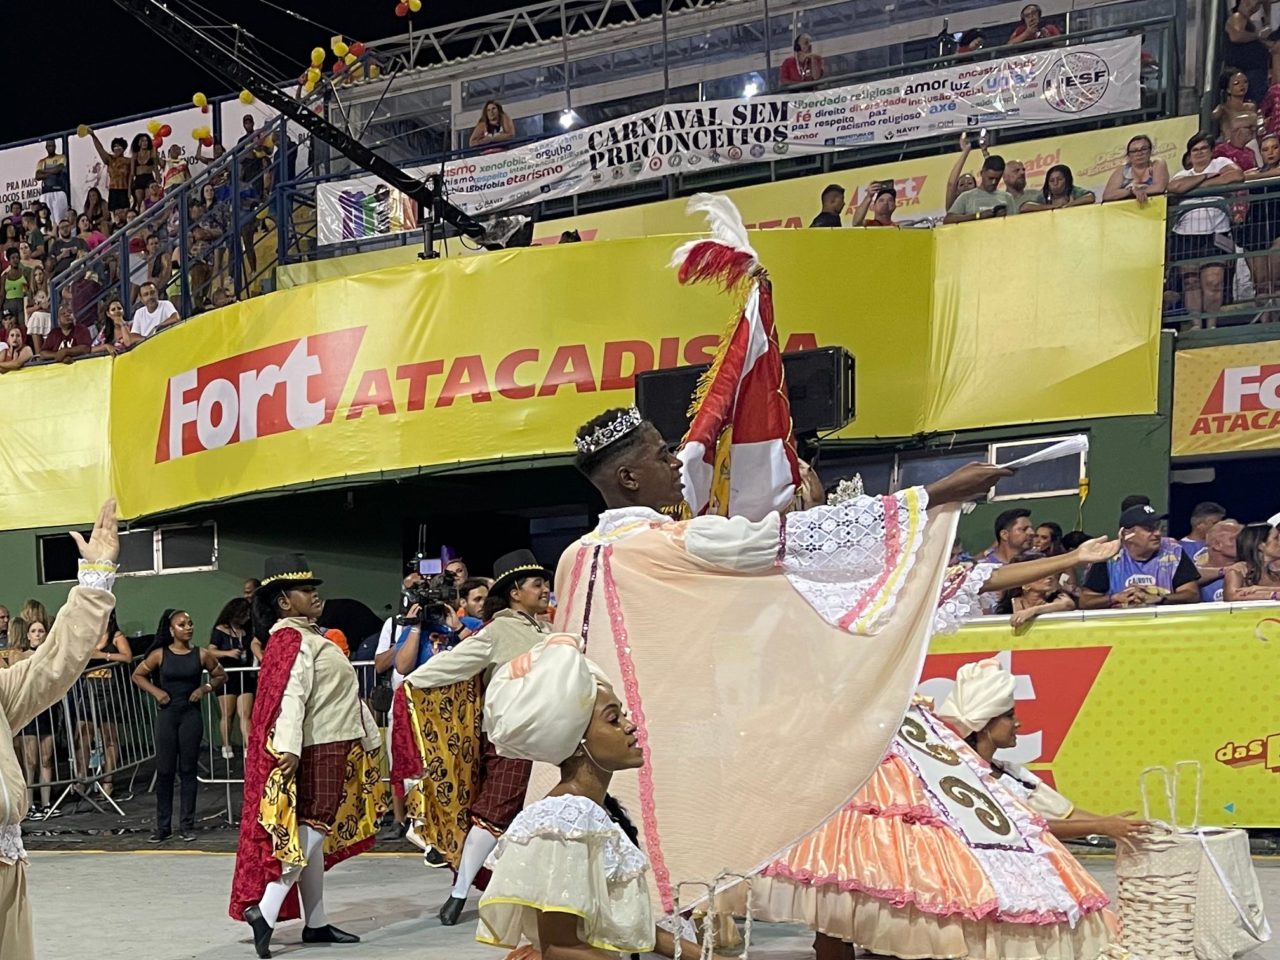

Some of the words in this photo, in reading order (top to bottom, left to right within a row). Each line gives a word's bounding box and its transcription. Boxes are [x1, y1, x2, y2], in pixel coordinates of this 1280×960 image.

[850, 85, 900, 101] religiosa
[904, 79, 949, 96] amor
[950, 81, 970, 92] luz
[796, 111, 811, 123] fé
[815, 107, 846, 118] direito
[955, 86, 984, 99] social
[869, 109, 887, 119] paz
[929, 100, 957, 114] axé
[588, 107, 723, 151] CARNAVAL
[732, 100, 790, 126] SEM
[792, 124, 809, 132] paz
[815, 116, 854, 128] respeito
[836, 119, 876, 132] racismo
[878, 111, 921, 126] religioso
[793, 131, 819, 140] amor
[589, 124, 789, 171] PRECONCEITOS
[480, 157, 526, 173] xenofobia
[535, 144, 572, 160] orgulho
[6, 181, 20, 191] PRA
[21, 178, 38, 189] MAIS
[506, 165, 563, 186] etarismo
[170, 336, 325, 460] Fort
[1215, 739, 1264, 763] das
